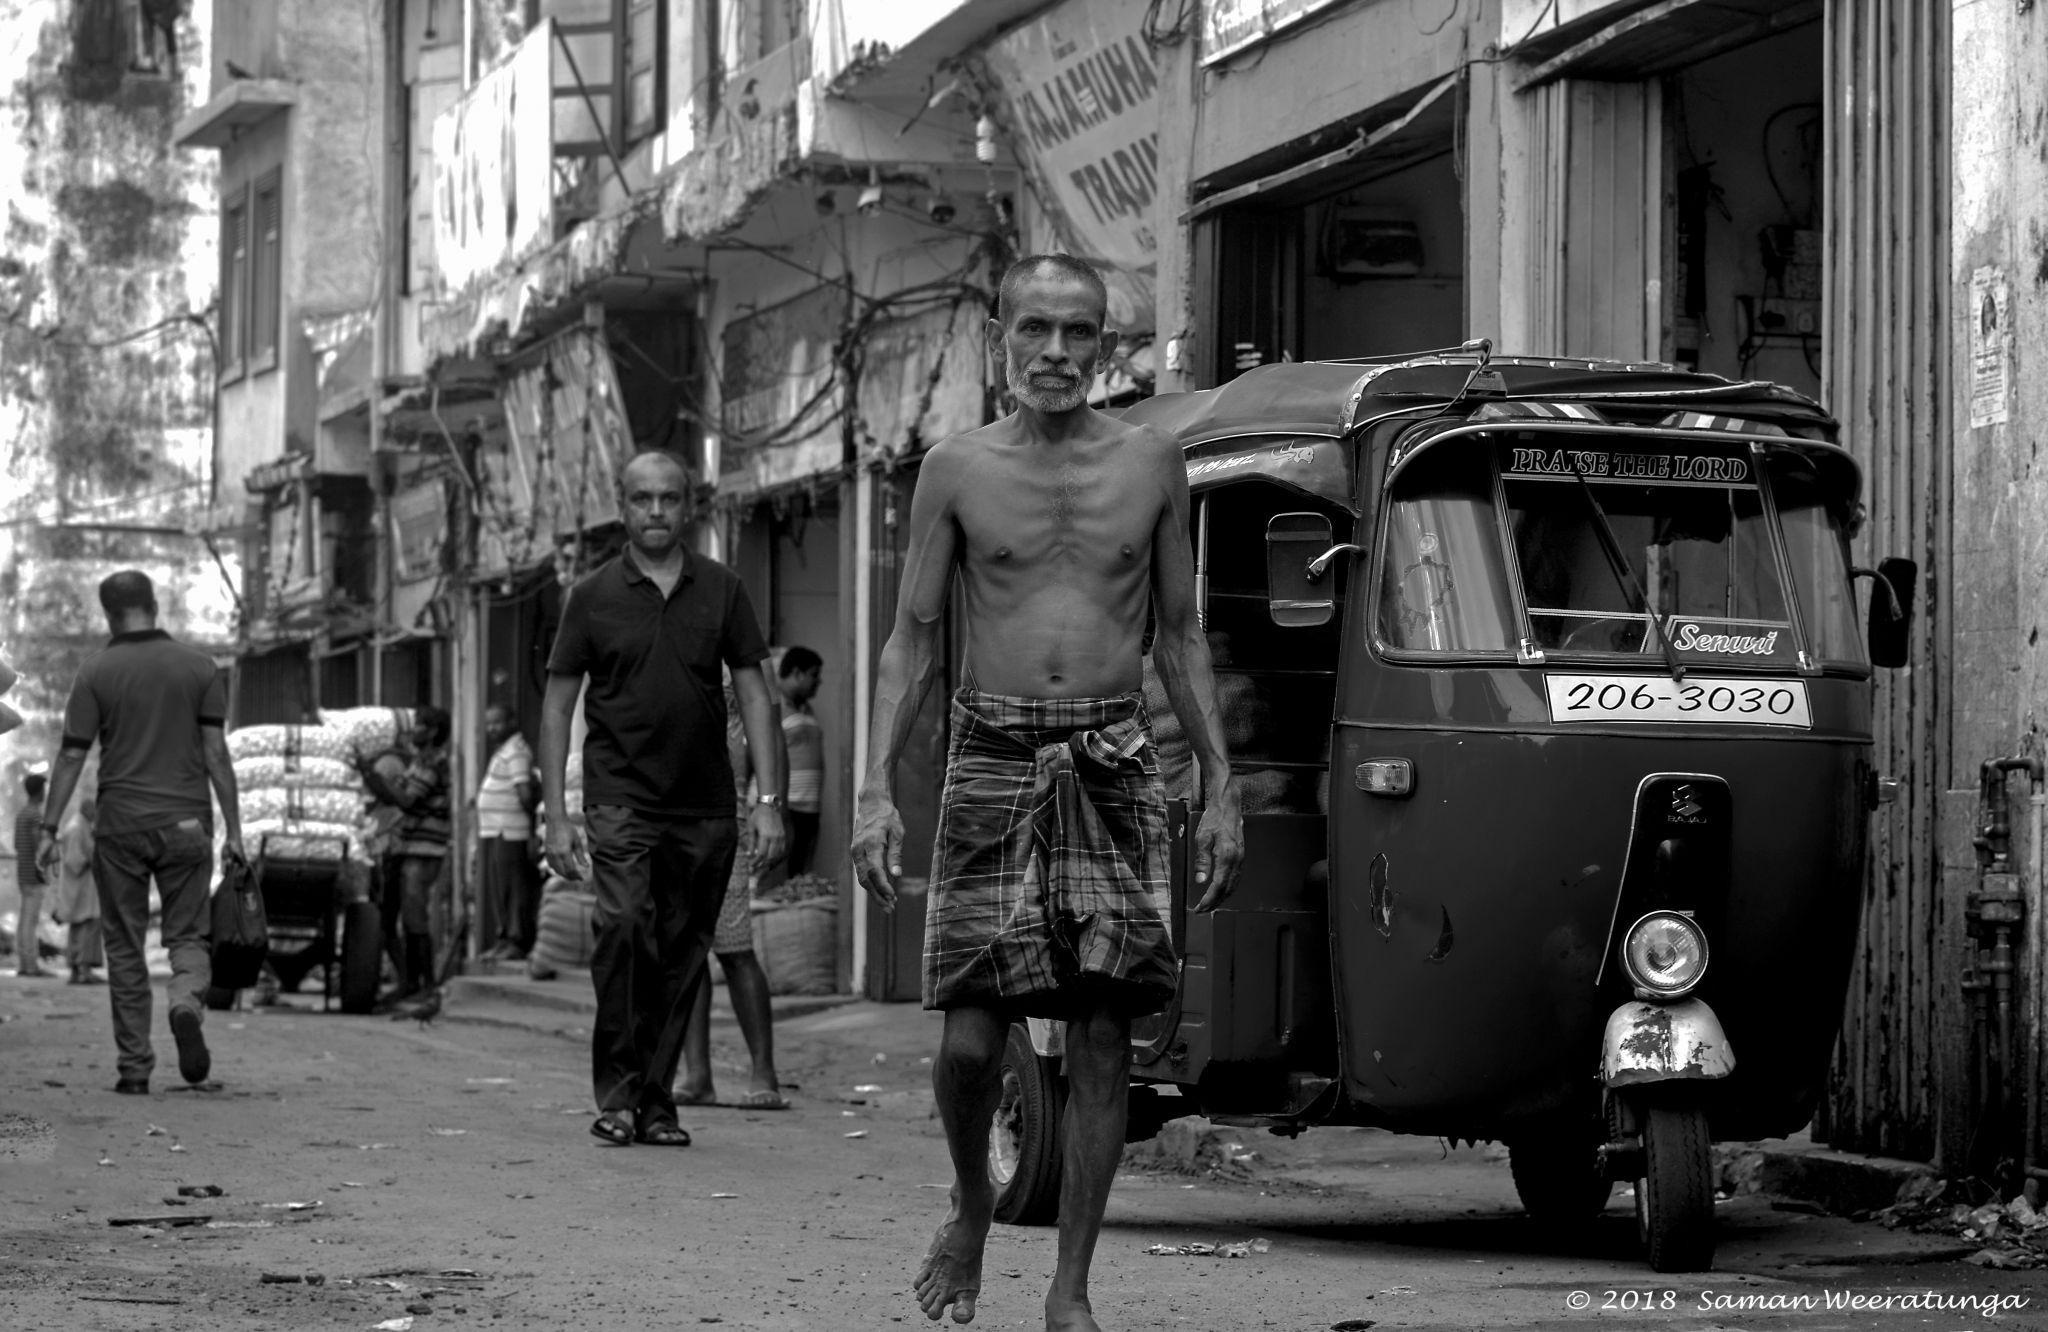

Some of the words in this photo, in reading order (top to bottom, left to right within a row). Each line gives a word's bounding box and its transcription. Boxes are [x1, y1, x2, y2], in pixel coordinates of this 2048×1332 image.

[1511, 448, 1609, 475] PRAISE
[1614, 452, 1670, 479] THE
[1673, 455, 1748, 481] LORD
[1567, 683, 1795, 714] 206-3030
